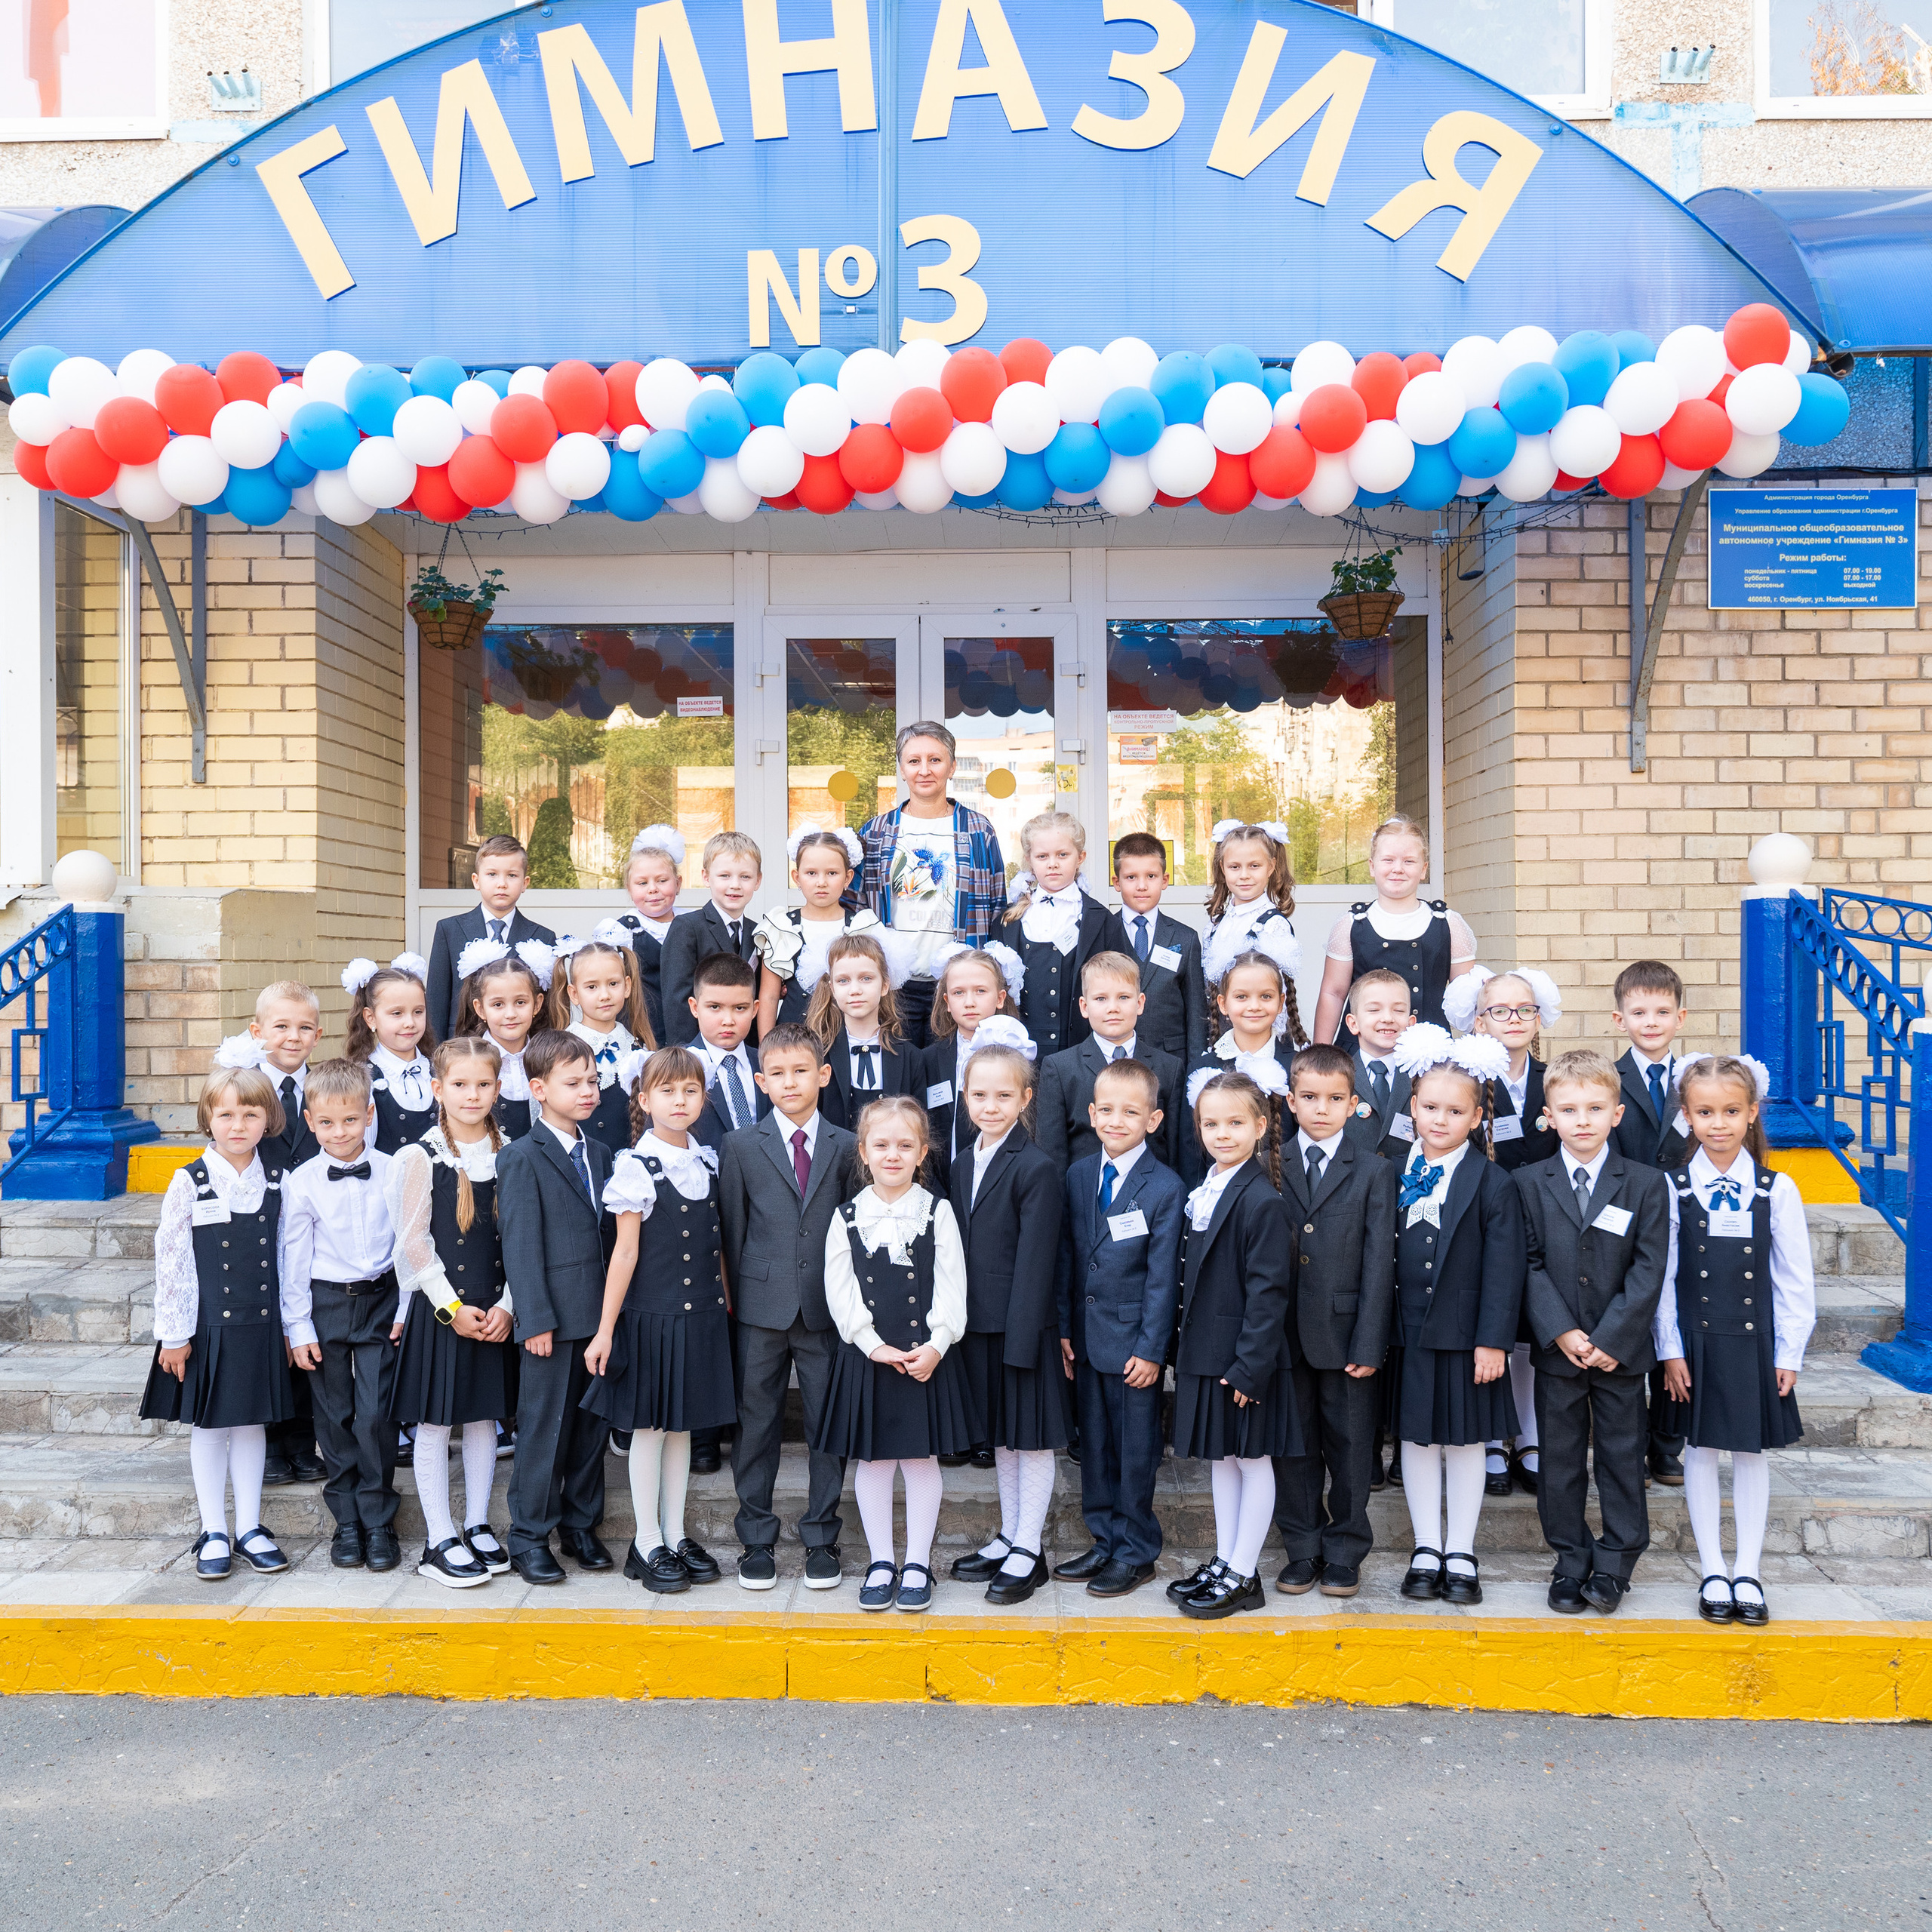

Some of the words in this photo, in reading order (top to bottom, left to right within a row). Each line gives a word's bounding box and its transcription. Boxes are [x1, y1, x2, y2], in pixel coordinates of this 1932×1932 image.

[254, 0, 1543, 300] ГИМНАЗИЯ
[901, 214, 989, 346] 3
[1724, 524, 1798, 534] Муниципальное
[1799, 524, 1905, 534] общеобразовательное
[1776, 538, 1832, 546] учреждение
[1834, 536, 1884, 544] «Гимназия
[1885, 536, 1897, 544] №
[1898, 536, 1909, 544] 3»
[1780, 554, 1809, 562] Режим
[1810, 553, 1847, 564] работы:
[1780, 596, 1814, 605] Оренбург,
